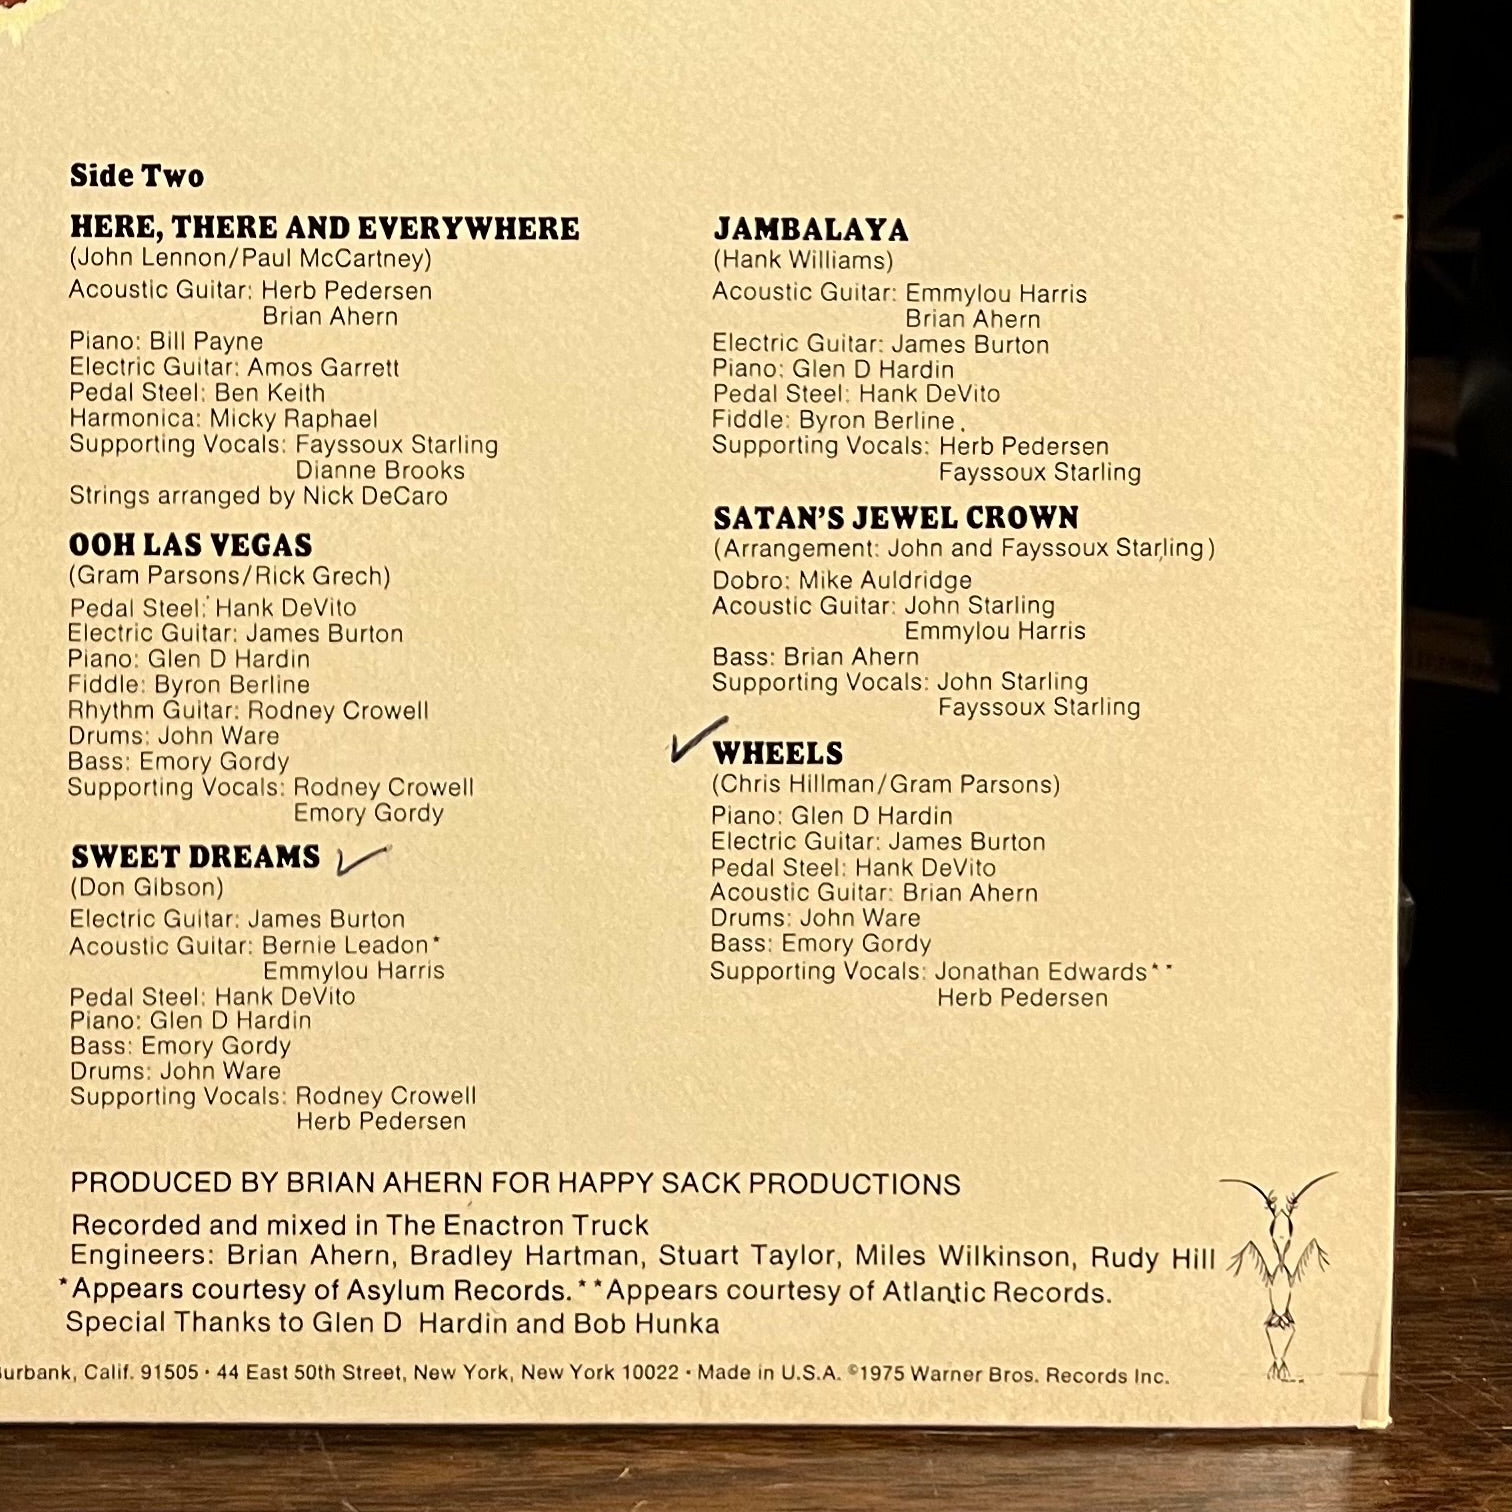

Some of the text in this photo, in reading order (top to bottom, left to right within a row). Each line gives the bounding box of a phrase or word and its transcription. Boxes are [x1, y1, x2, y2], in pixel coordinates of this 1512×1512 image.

[70, 162, 205, 188] Side Two
[70, 213, 580, 245] HERE, THERE AND EVERYWHERE
[713, 215, 909, 242] JAMBALAYA
[70, 245, 133, 271] (John
[300, 247, 432, 273] McCartney)
[714, 248, 893, 274] (Hank Williams)
[70, 355, 400, 378] Electric Guitar: Amos Garrett
[852, 505, 959, 530] JEWEL
[966, 504, 1079, 530] CROWN
[68, 531, 313, 558] OOH LAS VEGAS
[713, 569, 972, 595] Dobro: Mike Auldridge
[68, 750, 290, 776] Bass: Emory Gordy
[712, 740, 843, 766] WHEELS
[712, 773, 781, 798] (Chris
[960, 773, 1060, 798] Parsons)
[71, 843, 321, 869] SWEET DREAMS
[70, 876, 224, 901] (Don Gibson)
[71, 1170, 961, 1196] PRODUCED BY BRIAN AHERN FOR HAPPY SACK PRODUCTIONS
[72, 1213, 649, 1237] Recorded and mixed in The Enactron Truck
[66, 1309, 720, 1338] Special Thanks to Glen D Hardin and Bob Hunka
[84, 1363, 135, 1381] Calif.
[140, 1363, 199, 1381] 91505
[216, 1363, 239, 1380] 44
[246, 1363, 288, 1381] East
[294, 1363, 336, 1381] 50th
[342, 1363, 407, 1383] Street,
[413, 1364, 457, 1381] New
[463, 1363, 514, 1383] York,
[521, 1363, 564, 1381] New
[569, 1363, 615, 1381] York
[622, 1363, 679, 1381] 10022
[697, 1363, 751, 1381] Made
[758, 1364, 775, 1381] in
[781, 1364, 842, 1382] U.S.A.
[910, 1365, 983, 1383] Warner
[988, 1366, 1039, 1384] Bros.
[1046, 1366, 1128, 1385] Records
[1134, 1368, 1170, 1385] Inc.
